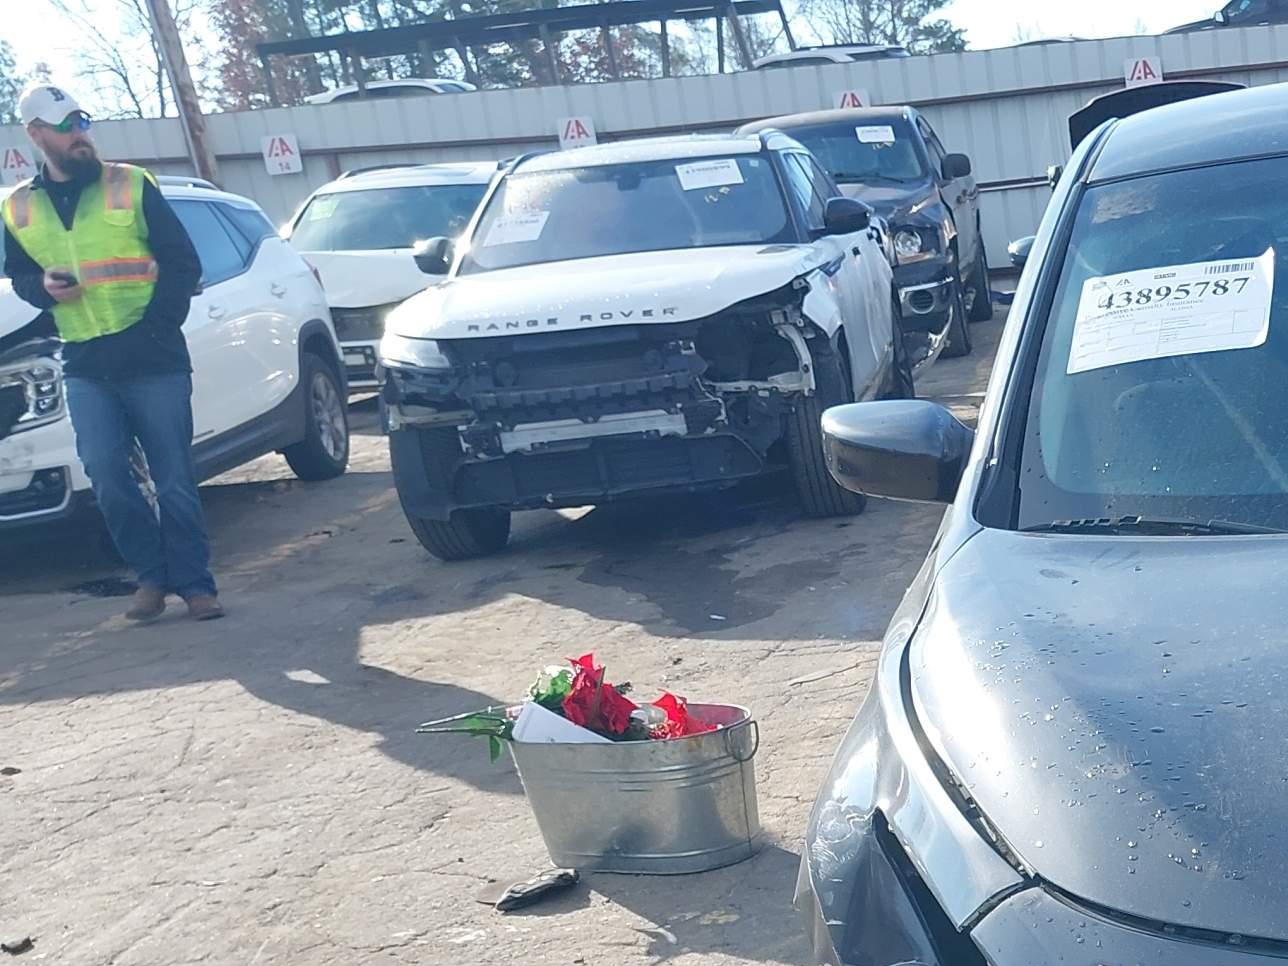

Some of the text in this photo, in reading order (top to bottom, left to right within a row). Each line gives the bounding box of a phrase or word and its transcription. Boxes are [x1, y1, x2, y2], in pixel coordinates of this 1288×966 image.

[1097, 276, 1250, 310] 43895787
[467, 306, 678, 332] RANGE ROVER
